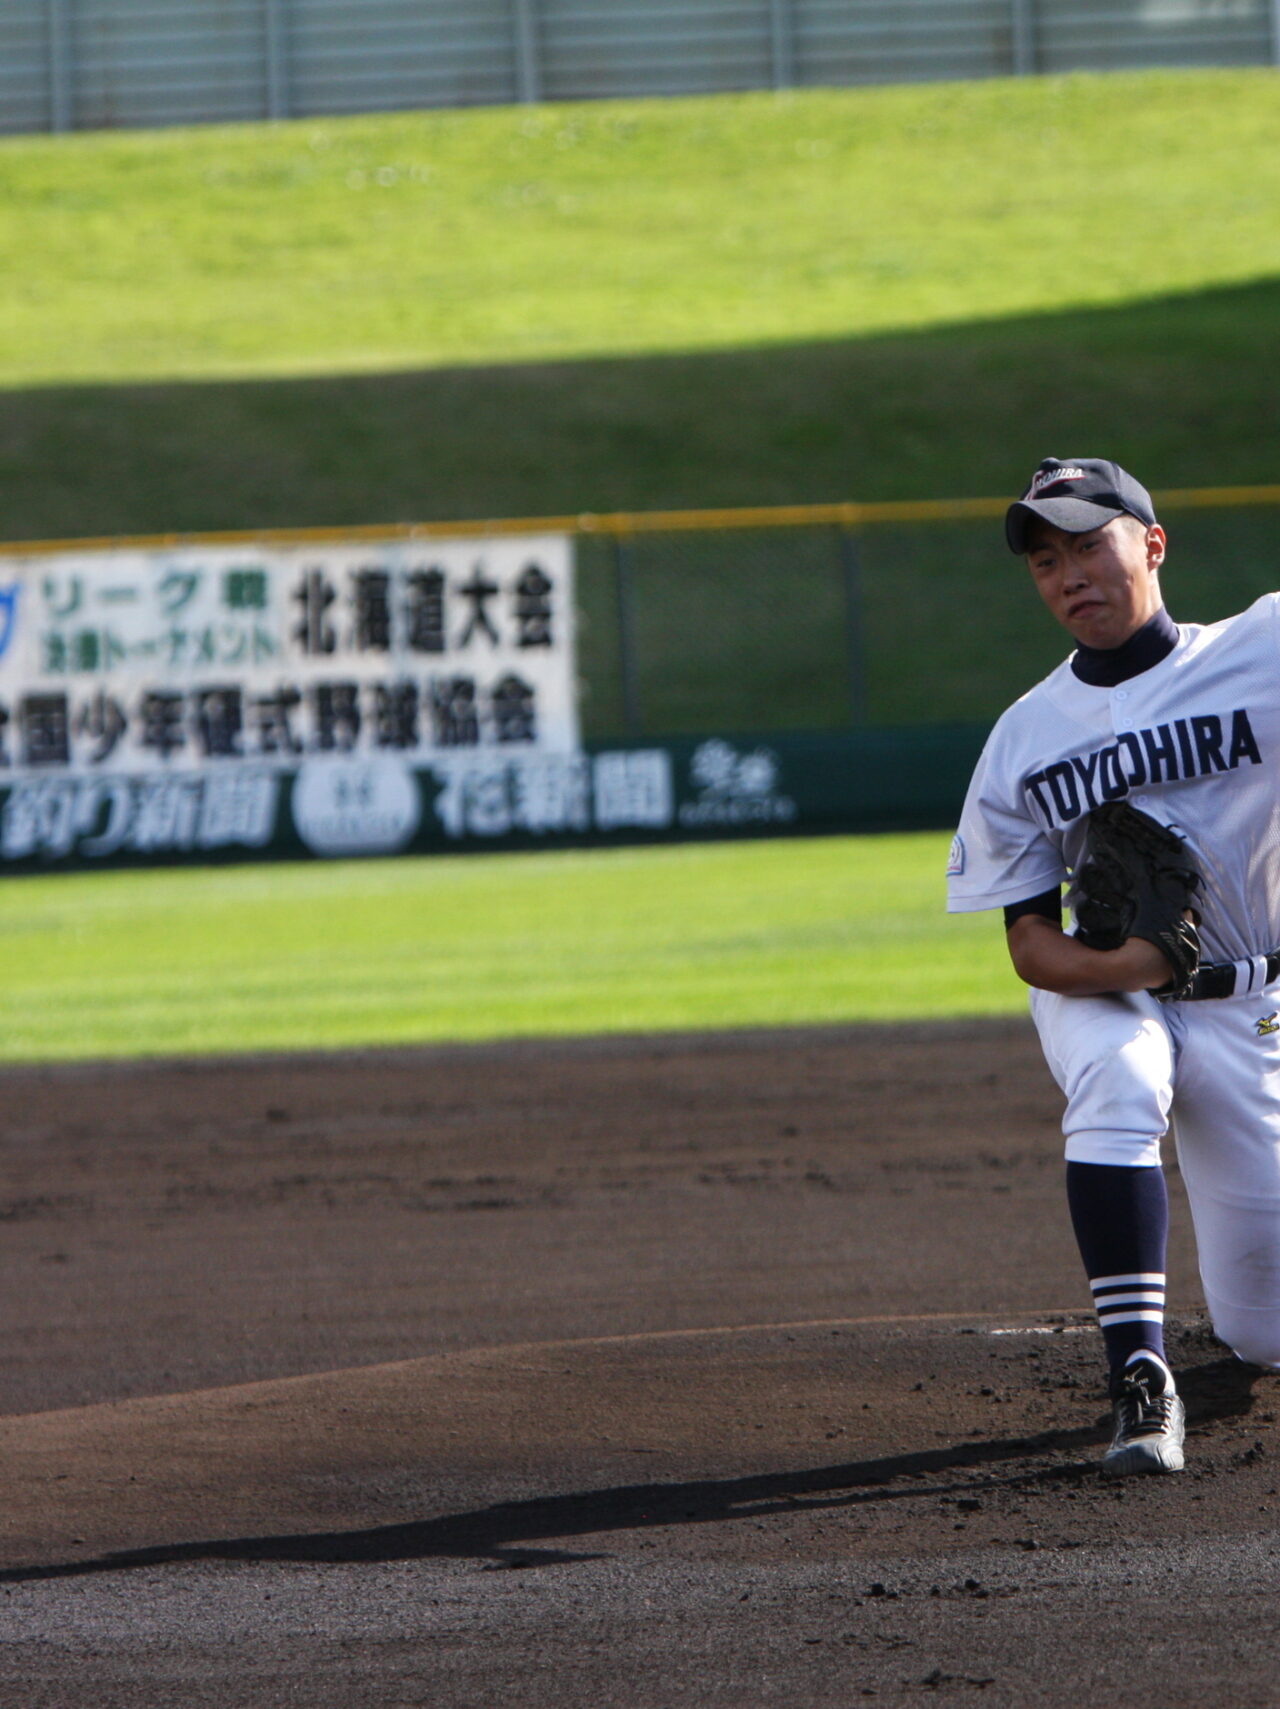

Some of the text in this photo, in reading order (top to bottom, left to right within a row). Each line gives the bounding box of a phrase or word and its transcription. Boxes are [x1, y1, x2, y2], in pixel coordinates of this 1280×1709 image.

[294, 560, 553, 655] 北海道大会
[0, 671, 536, 768] 国少年硬式野球協会
[1024, 708, 1263, 829] TOYOHIRA
